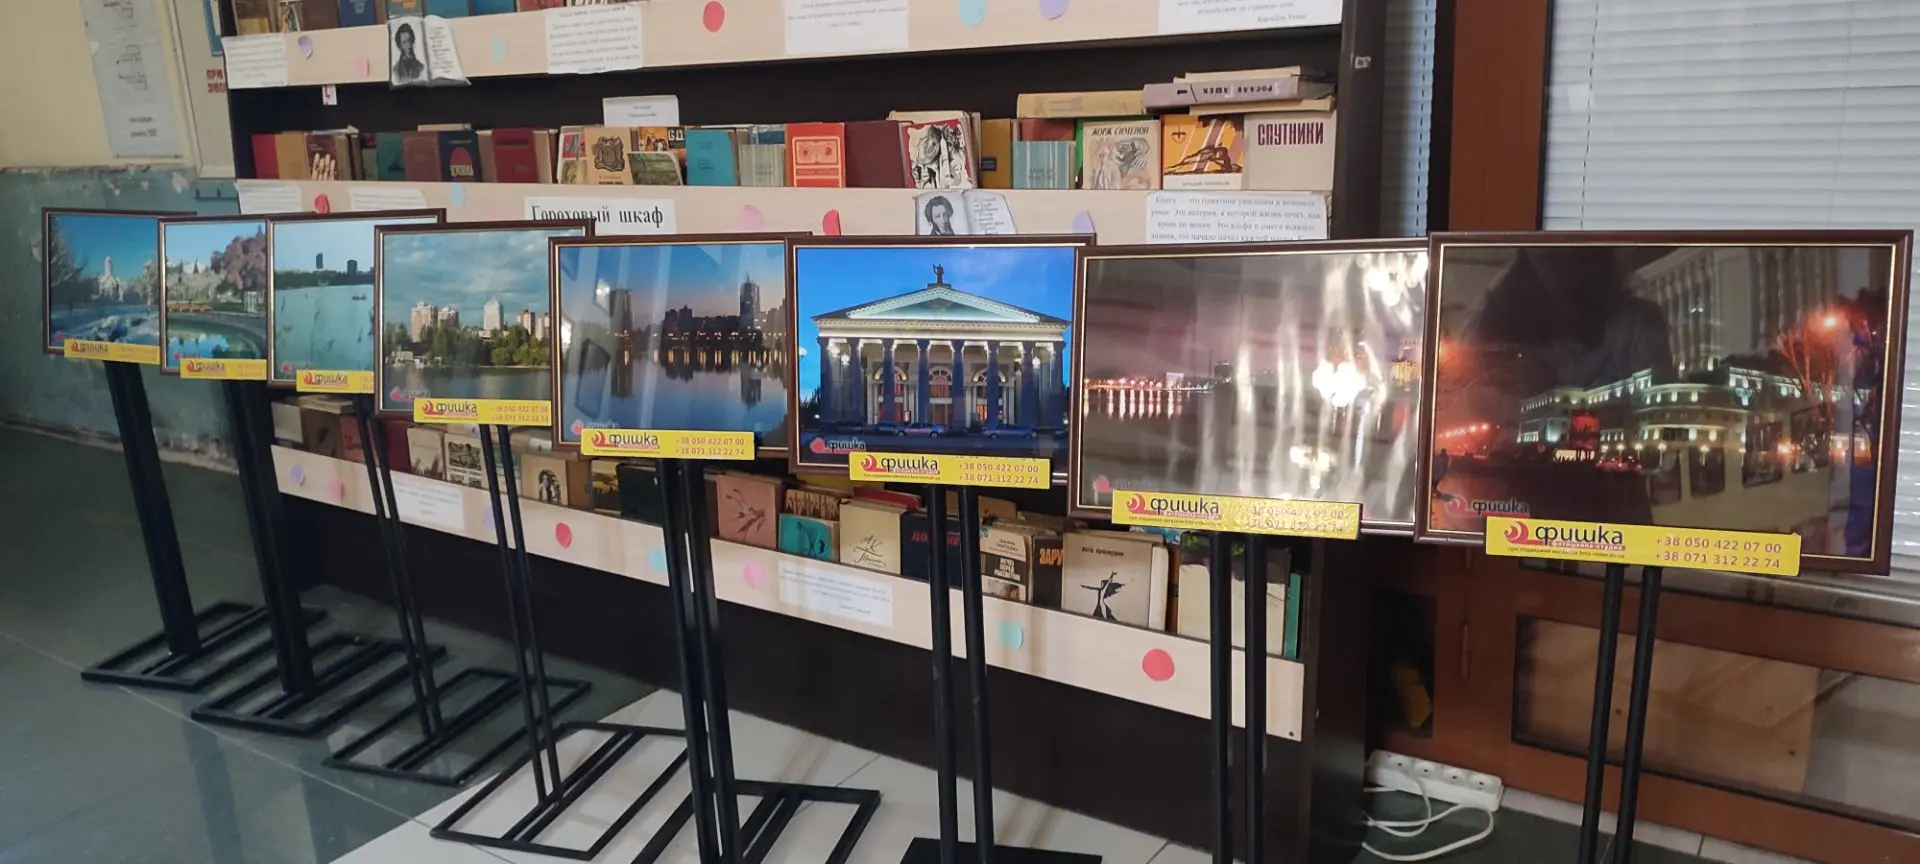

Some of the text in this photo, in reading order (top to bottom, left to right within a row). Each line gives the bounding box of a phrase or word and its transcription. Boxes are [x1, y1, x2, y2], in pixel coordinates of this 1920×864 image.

[1257, 122, 1325, 146] СПУТНИКИ
[531, 205, 664, 229] Гороховый шкаф
[436, 401, 477, 414] фишка
[608, 432, 658, 447] фишка
[881, 455, 938, 473] фишка
[976, 463, 993, 472] 050
[995, 464, 1012, 472] 422
[1014, 464, 1025, 473] 07
[1027, 465, 1039, 473] 00
[976, 474, 993, 482] 071
[995, 475, 1012, 483] 312
[1014, 475, 1025, 484] 22
[1027, 476, 1039, 484] 74
[1150, 496, 1220, 515] фишка
[1472, 498, 1529, 516] фишка
[1535, 524, 1624, 545] фишка
[1684, 538, 1710, 548] 050
[1714, 539, 1739, 550] 422
[1743, 541, 1760, 552] 07
[1764, 543, 1782, 553] 00
[1040, 548, 1063, 566] ЗАРУ
[1684, 553, 1708, 563] 071
[1713, 554, 1738, 566] 312
[1743, 557, 1759, 567] 22
[1764, 558, 1780, 568] 74
